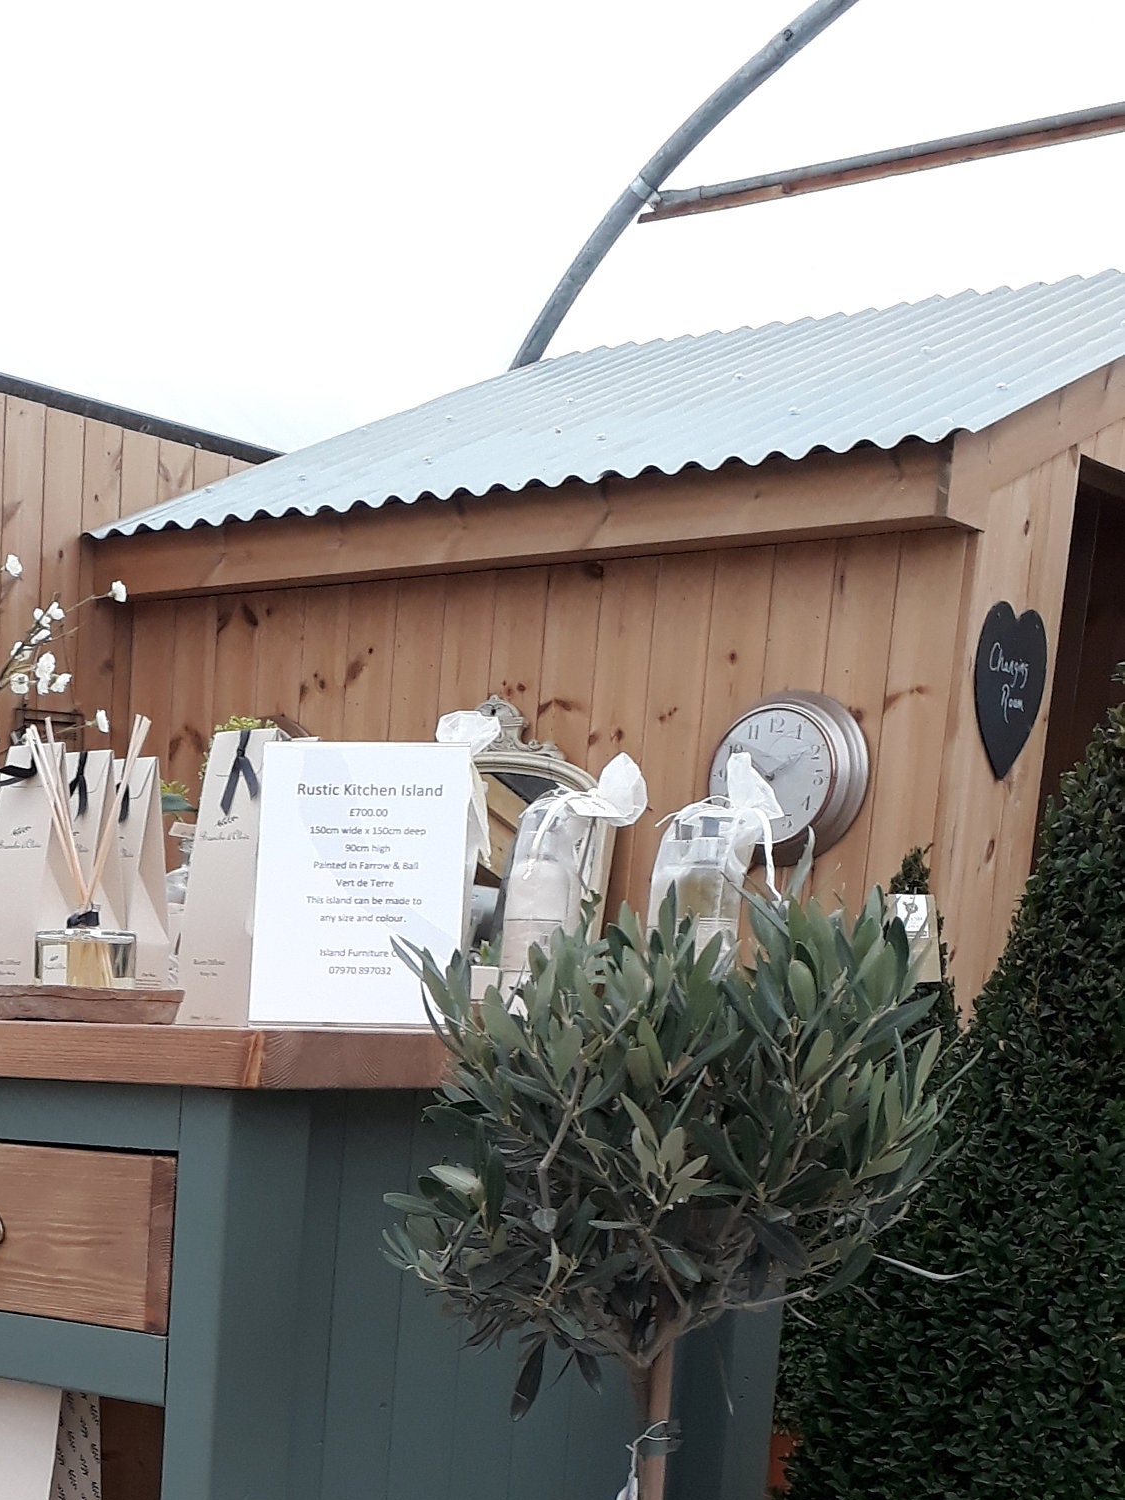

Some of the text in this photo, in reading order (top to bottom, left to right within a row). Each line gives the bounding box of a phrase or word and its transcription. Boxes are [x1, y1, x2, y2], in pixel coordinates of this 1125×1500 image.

[769, 717, 785, 733] 12
[748, 724, 760, 740] 11
[811, 744, 821, 760] 2
[296, 783, 444, 797] Rustic Kitchen Island
[349, 808, 389, 817] £700.00
[309, 826, 340, 835] 150cm
[341, 826, 363, 835] wide
[372, 827, 402, 836] 150cm
[403, 827, 427, 837] deep
[344, 844, 391, 854] 90cm high
[313, 861, 419, 870] Painted in Farrow & Ball
[335, 879, 394, 888] Vert de Terre
[306, 896, 423, 906] This island can be made to
[319, 914, 407, 923] any size and colour.
[319, 948, 346, 957] Island
[347, 948, 389, 958] Furniture
[328, 966, 357, 975] 07970
